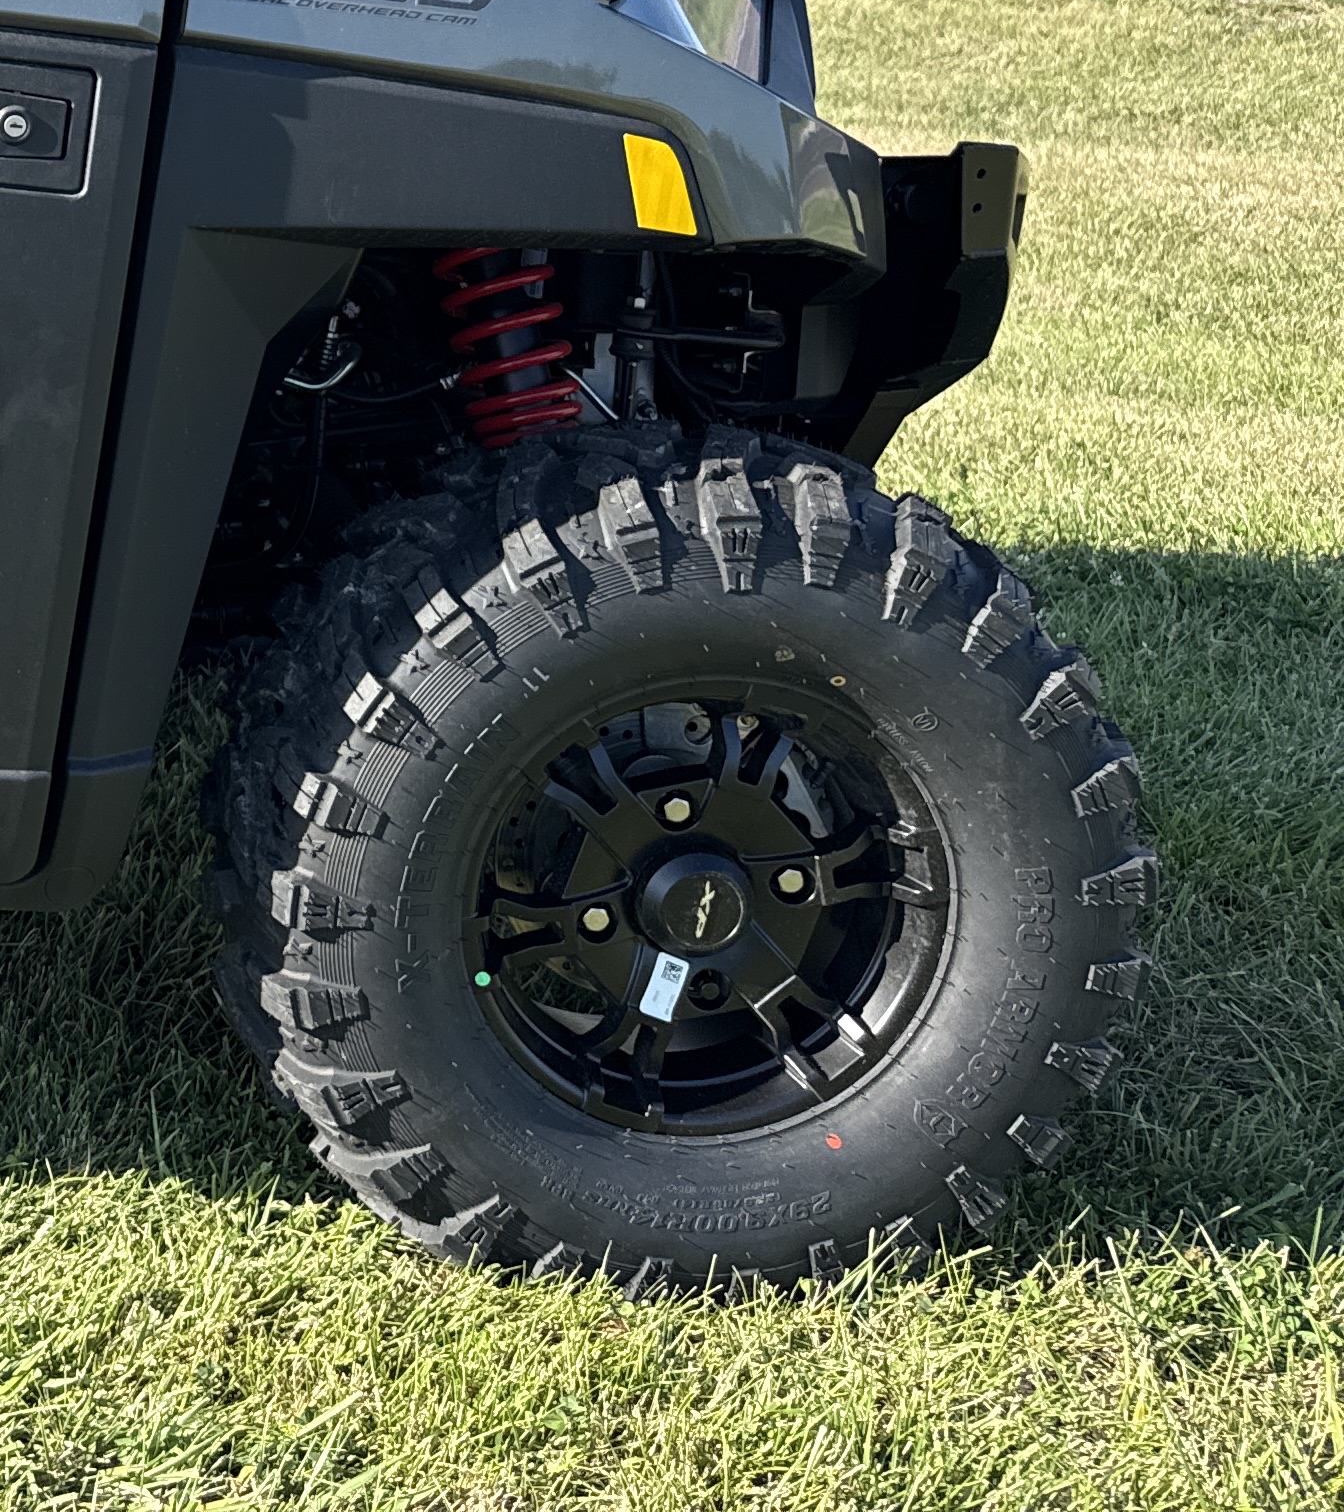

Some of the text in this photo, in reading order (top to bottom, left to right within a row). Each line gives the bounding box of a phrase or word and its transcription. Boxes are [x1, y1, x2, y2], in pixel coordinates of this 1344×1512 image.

[425, 13, 478, 26] CAM
[395, 713, 516, 994] X-TERRAIN
[946, 866, 1055, 1112] PRO ARMOR
